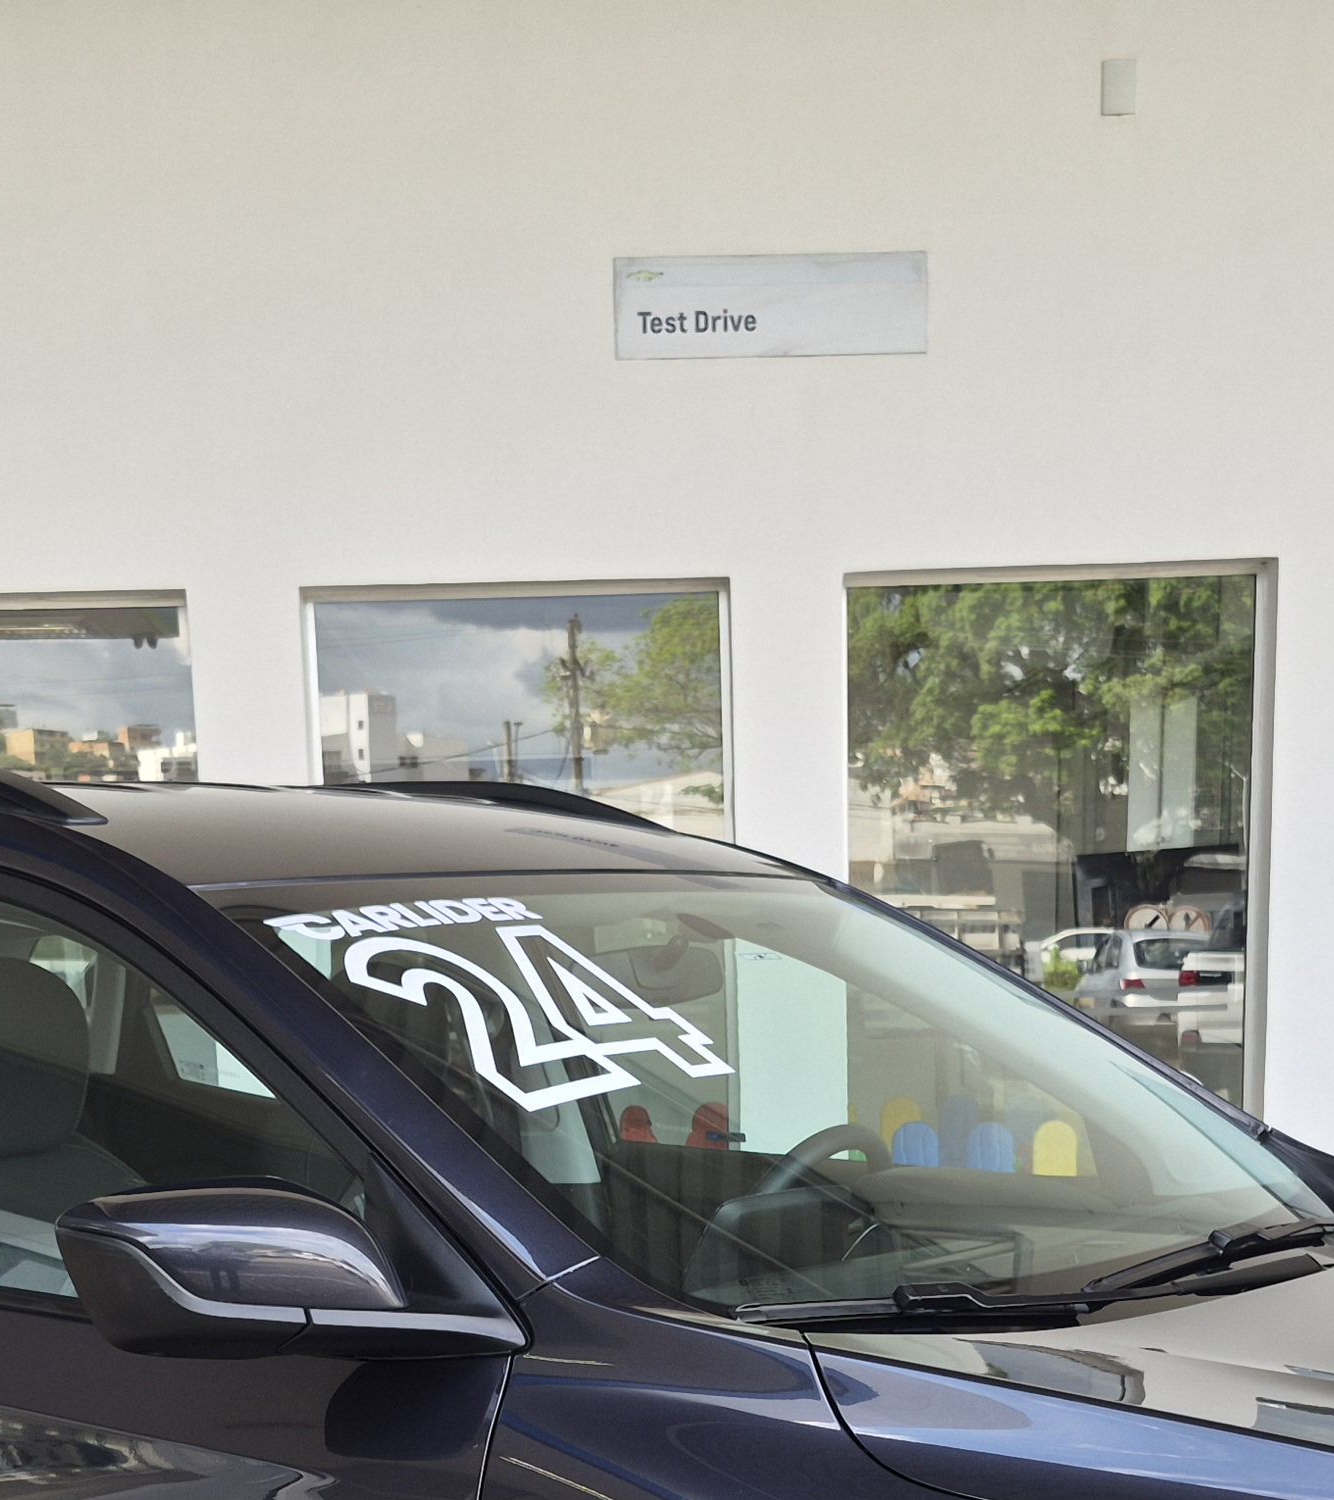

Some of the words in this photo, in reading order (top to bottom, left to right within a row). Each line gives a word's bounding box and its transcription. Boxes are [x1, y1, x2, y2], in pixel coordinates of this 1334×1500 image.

[636, 311, 688, 335] Test
[694, 308, 757, 334] Drive
[262, 896, 544, 941] CARLIDER
[343, 924, 736, 1112] 24
